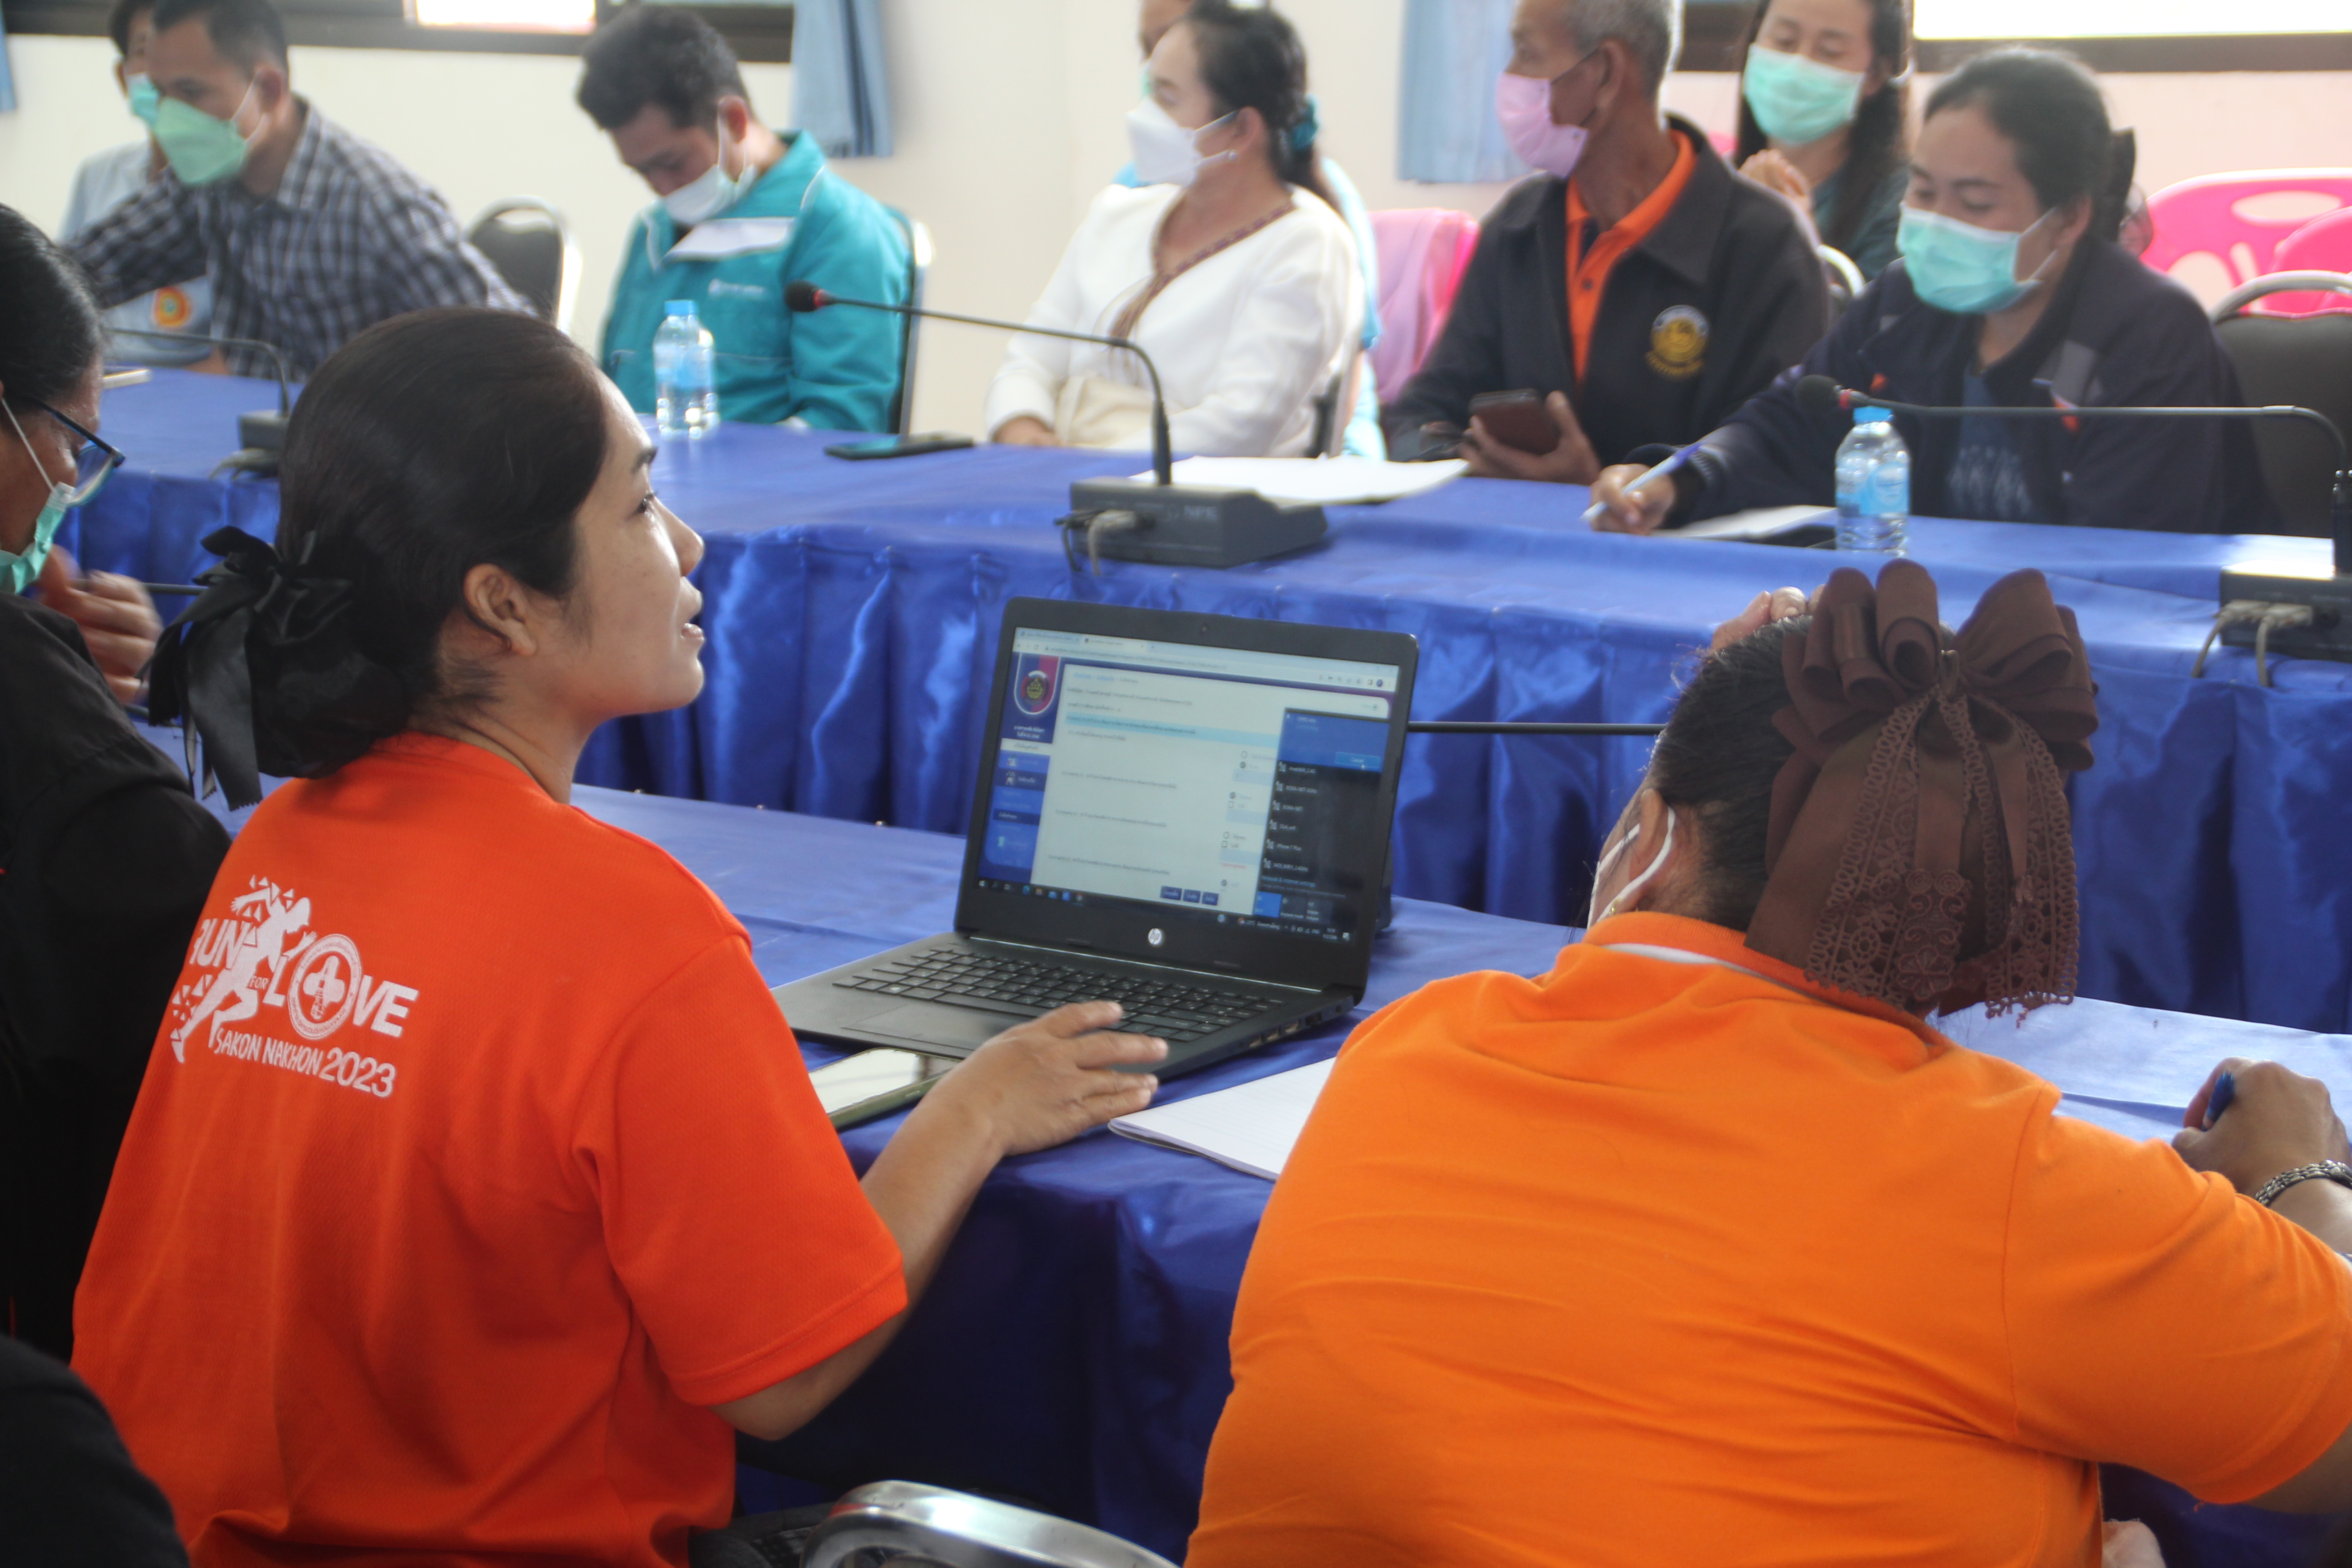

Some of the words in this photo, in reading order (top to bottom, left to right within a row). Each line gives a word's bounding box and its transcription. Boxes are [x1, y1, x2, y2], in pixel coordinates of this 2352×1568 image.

[1148, 928, 1162, 945] hp
[249, 975, 269, 990] FOR
[214, 1027, 262, 1062] SAKON
[262, 1037, 323, 1075] NAKHON
[318, 1047, 397, 1098] 2023
